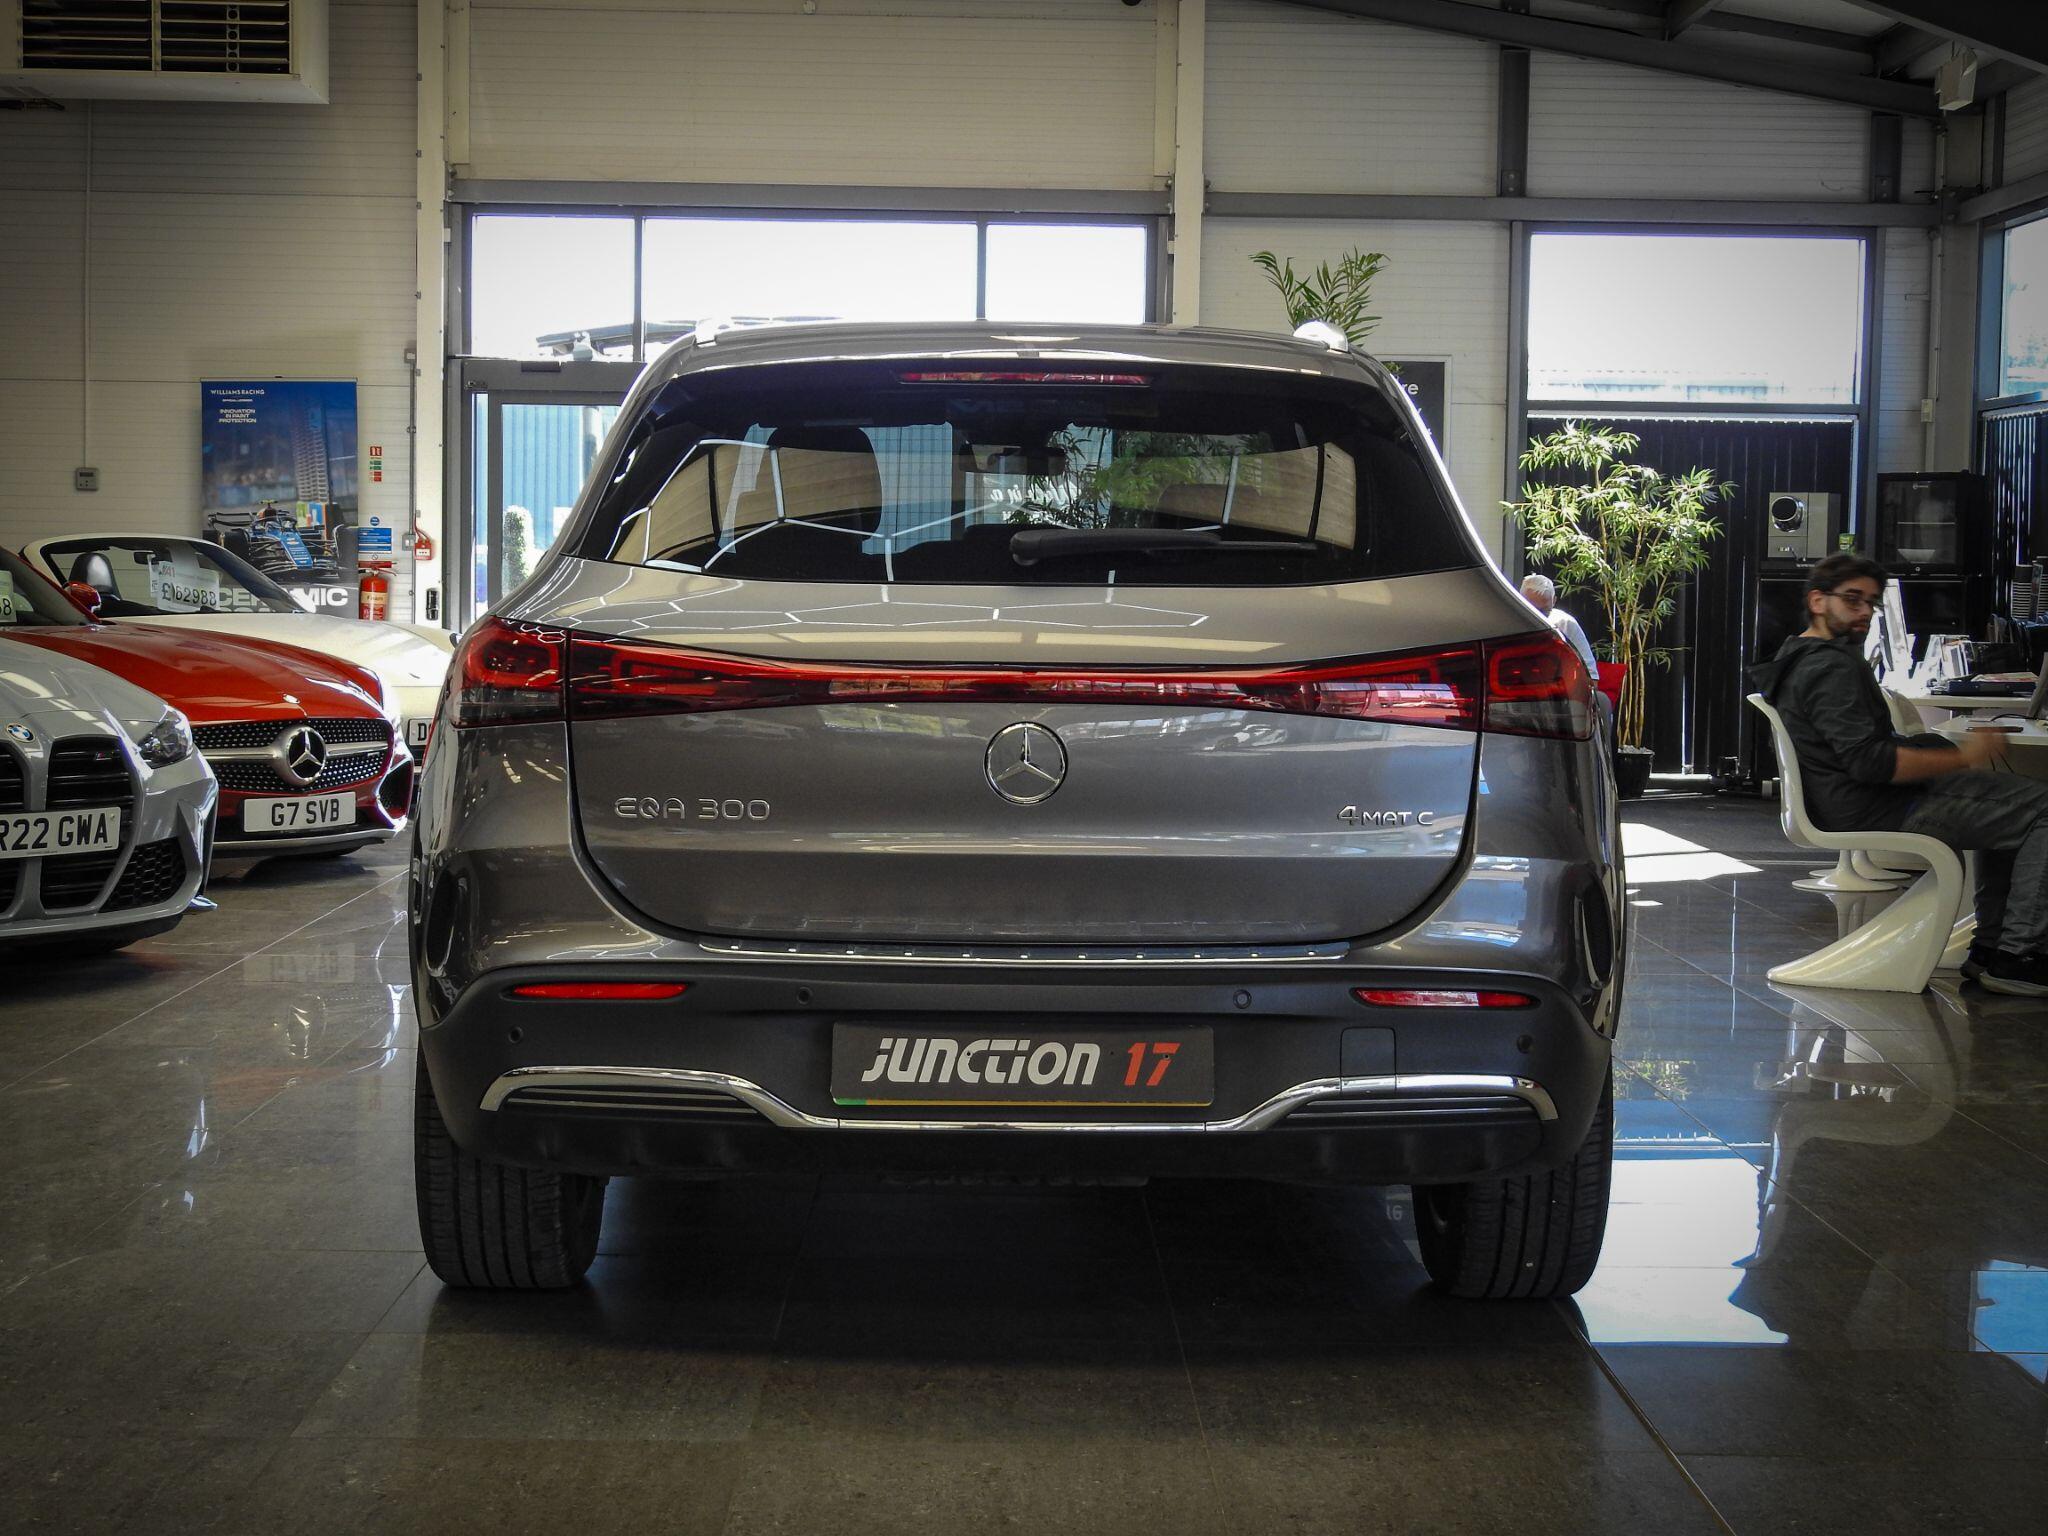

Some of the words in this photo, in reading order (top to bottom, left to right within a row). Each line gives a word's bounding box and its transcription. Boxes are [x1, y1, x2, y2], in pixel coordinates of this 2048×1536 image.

[271, 802, 300, 827] G7
[306, 798, 340, 824] SVB
[614, 797, 686, 819] EQA
[698, 798, 770, 820] 300
[58, 813, 108, 847] GWA
[1123, 1042, 1182, 1086] 17
